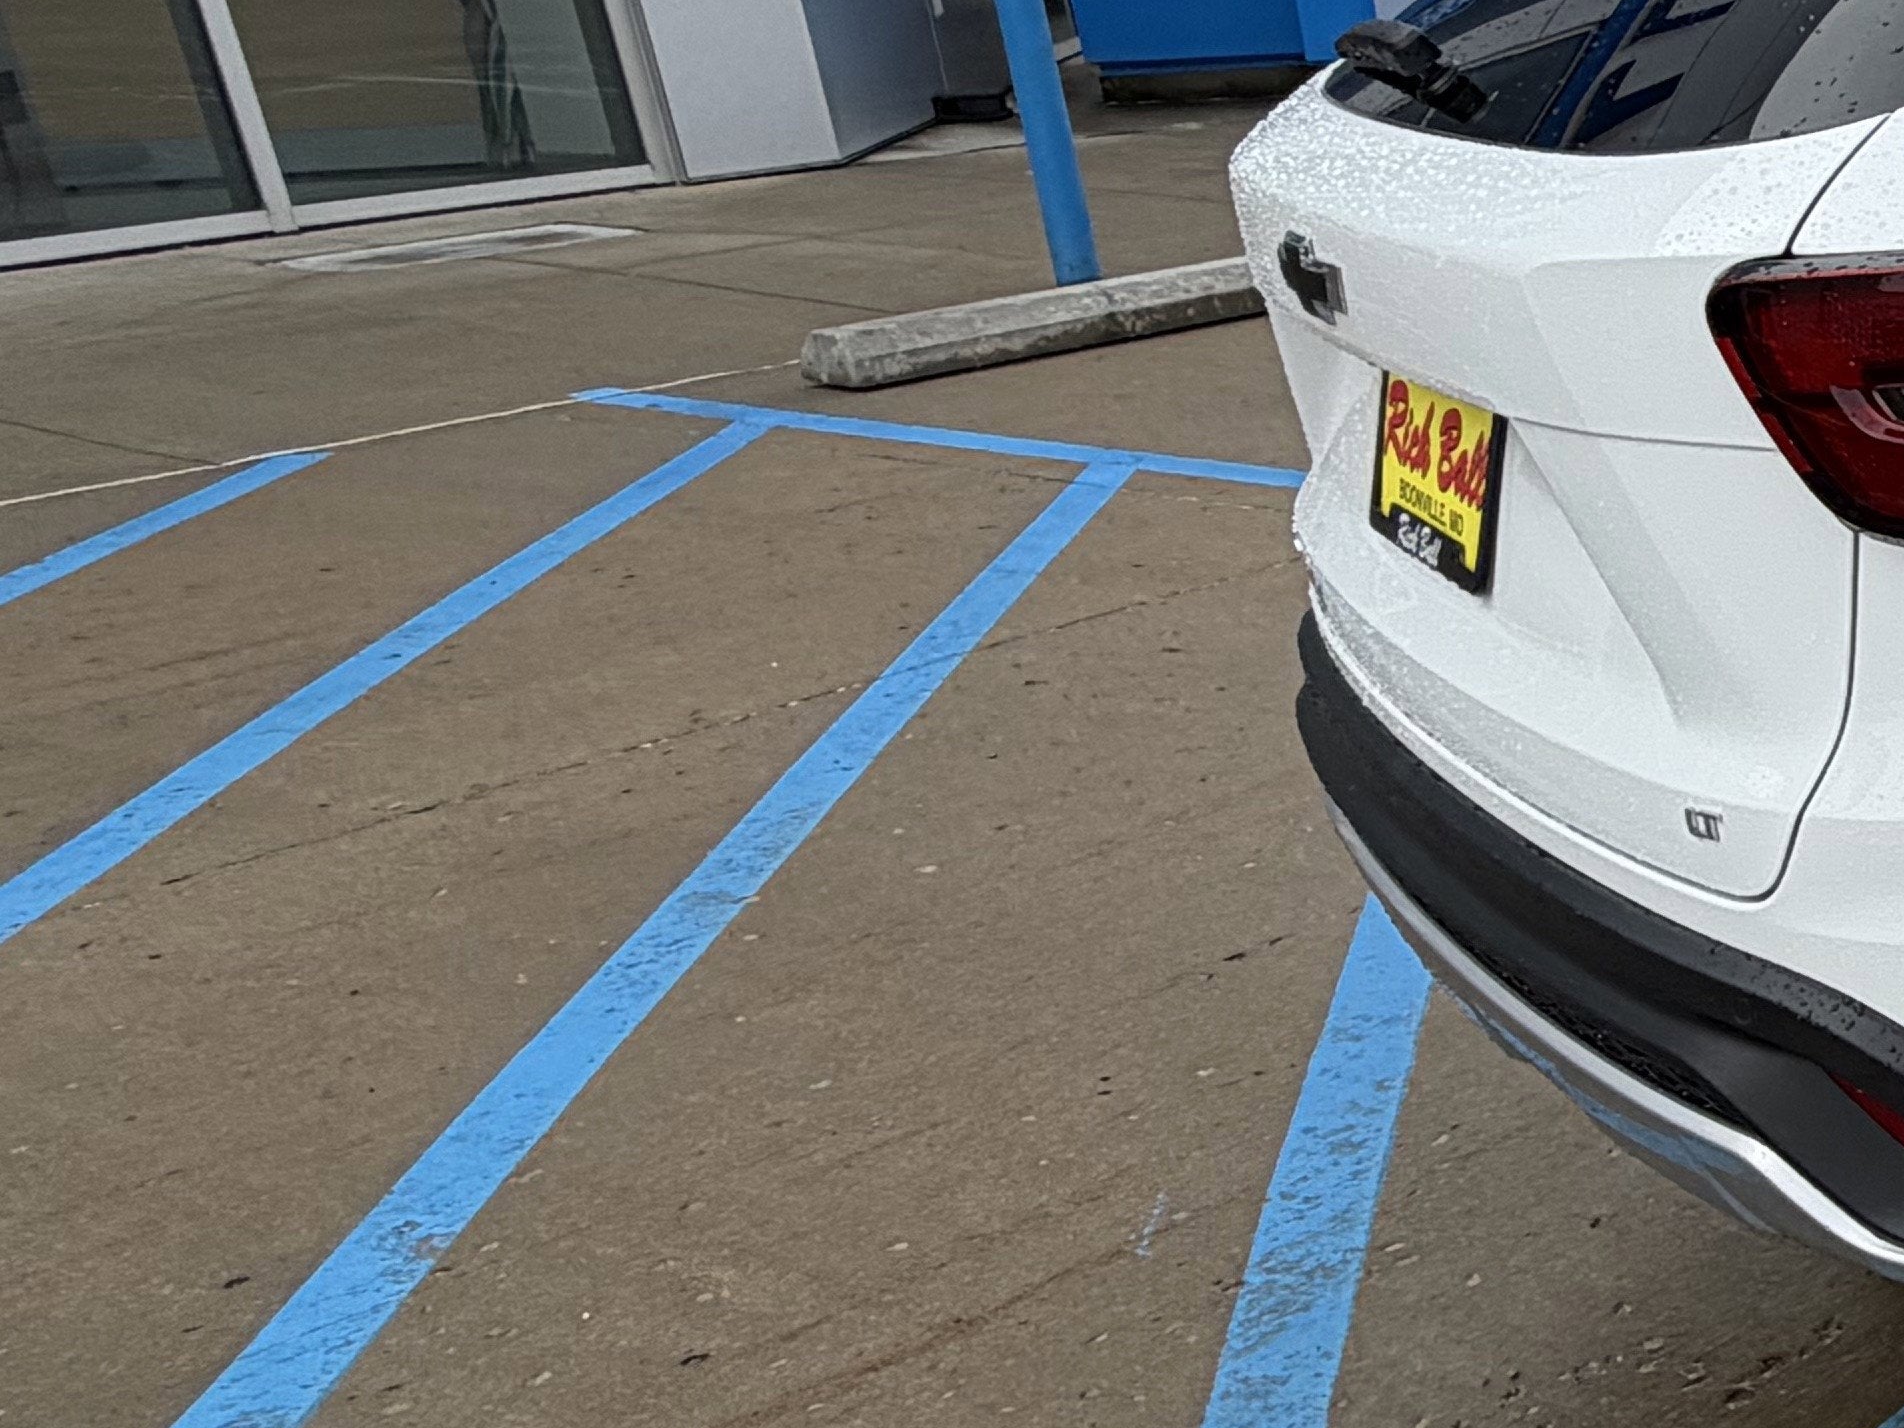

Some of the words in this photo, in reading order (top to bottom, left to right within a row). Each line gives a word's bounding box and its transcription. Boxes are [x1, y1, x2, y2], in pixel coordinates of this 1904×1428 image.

[1383, 380, 1436, 480] Rick
[1437, 408, 1490, 512] Ball
[1399, 478, 1446, 520] BOONVILLE
[1684, 807, 1723, 843] LT
